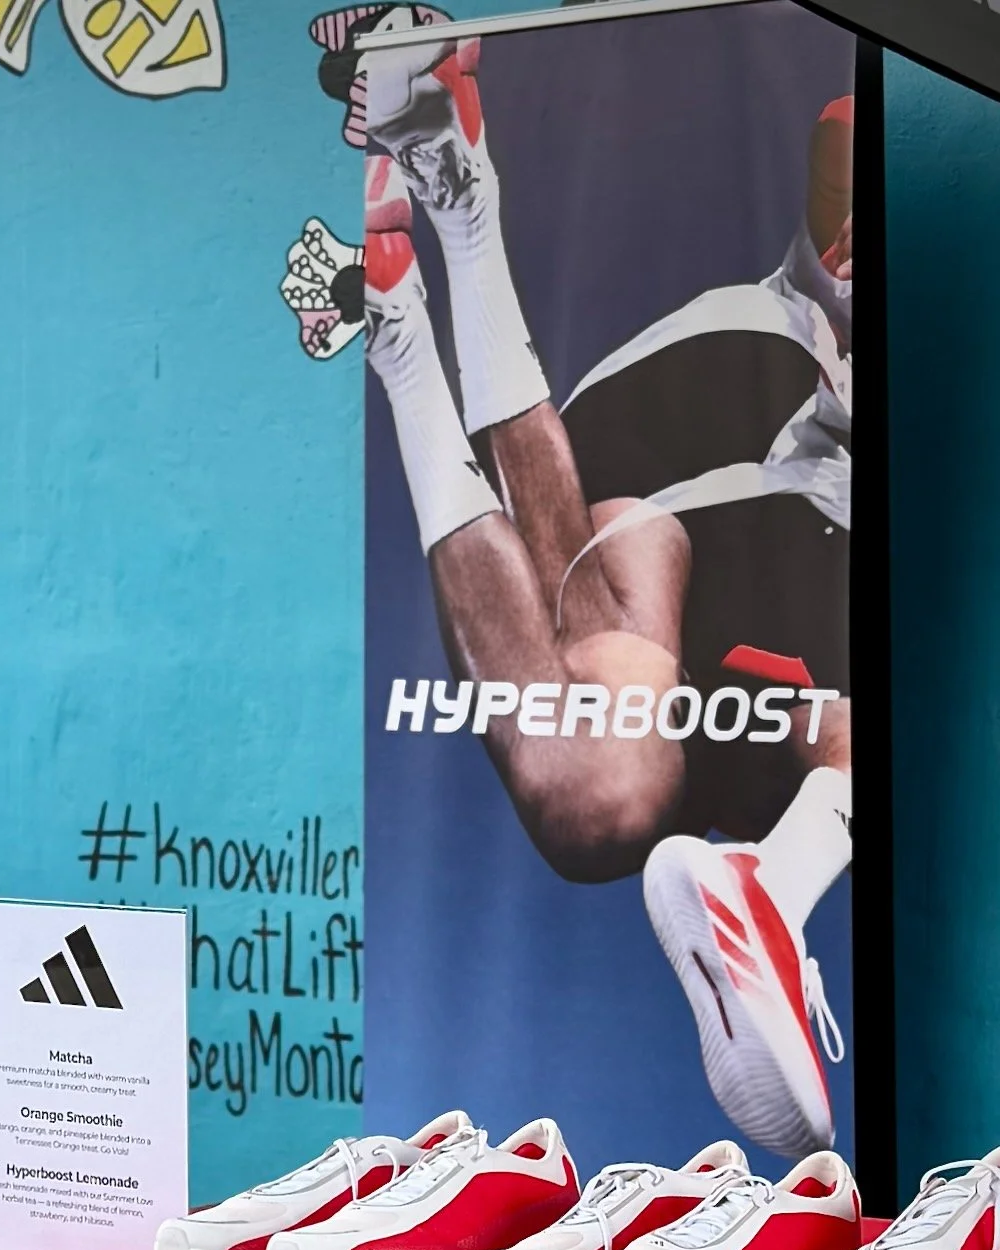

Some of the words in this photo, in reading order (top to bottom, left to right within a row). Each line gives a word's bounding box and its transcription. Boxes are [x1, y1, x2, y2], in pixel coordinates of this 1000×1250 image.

[385, 679, 840, 744] HYPERBOOST
[188, 905, 364, 1003] hatLift
[49, 1050, 93, 1064] Matcha
[29, 1068, 56, 1076] matcha
[57, 1069, 86, 1079] blended
[105, 1075, 126, 1083] warm
[127, 1077, 150, 1085] vanilla
[7, 1078, 42, 1087] sweetness
[60, 1084, 89, 1093] smooth,
[91, 1087, 117, 1096] creamy
[21, 1107, 63, 1123] Orange
[67, 1111, 123, 1127] Smoothie
[15, 1137, 51, 1146] Tennessee
[53, 1140, 80, 1152] Orange
[101, 1146, 112, 1154] Go
[64, 1130, 98, 1140] pineapple
[100, 1133, 129, 1143] blended
[7, 1164, 73, 1181] Hyperboost
[76, 1172, 138, 1189] Lemonade
[13, 1183, 48, 1193] lemonade
[50, 1188, 71, 1196] mixed
[103, 1193, 135, 1203] Summer
[2, 1194, 22, 1203] herbal
[52, 1201, 87, 1211] refreshing
[89, 1204, 109, 1213] blend
[70, 1214, 83, 1223] and
